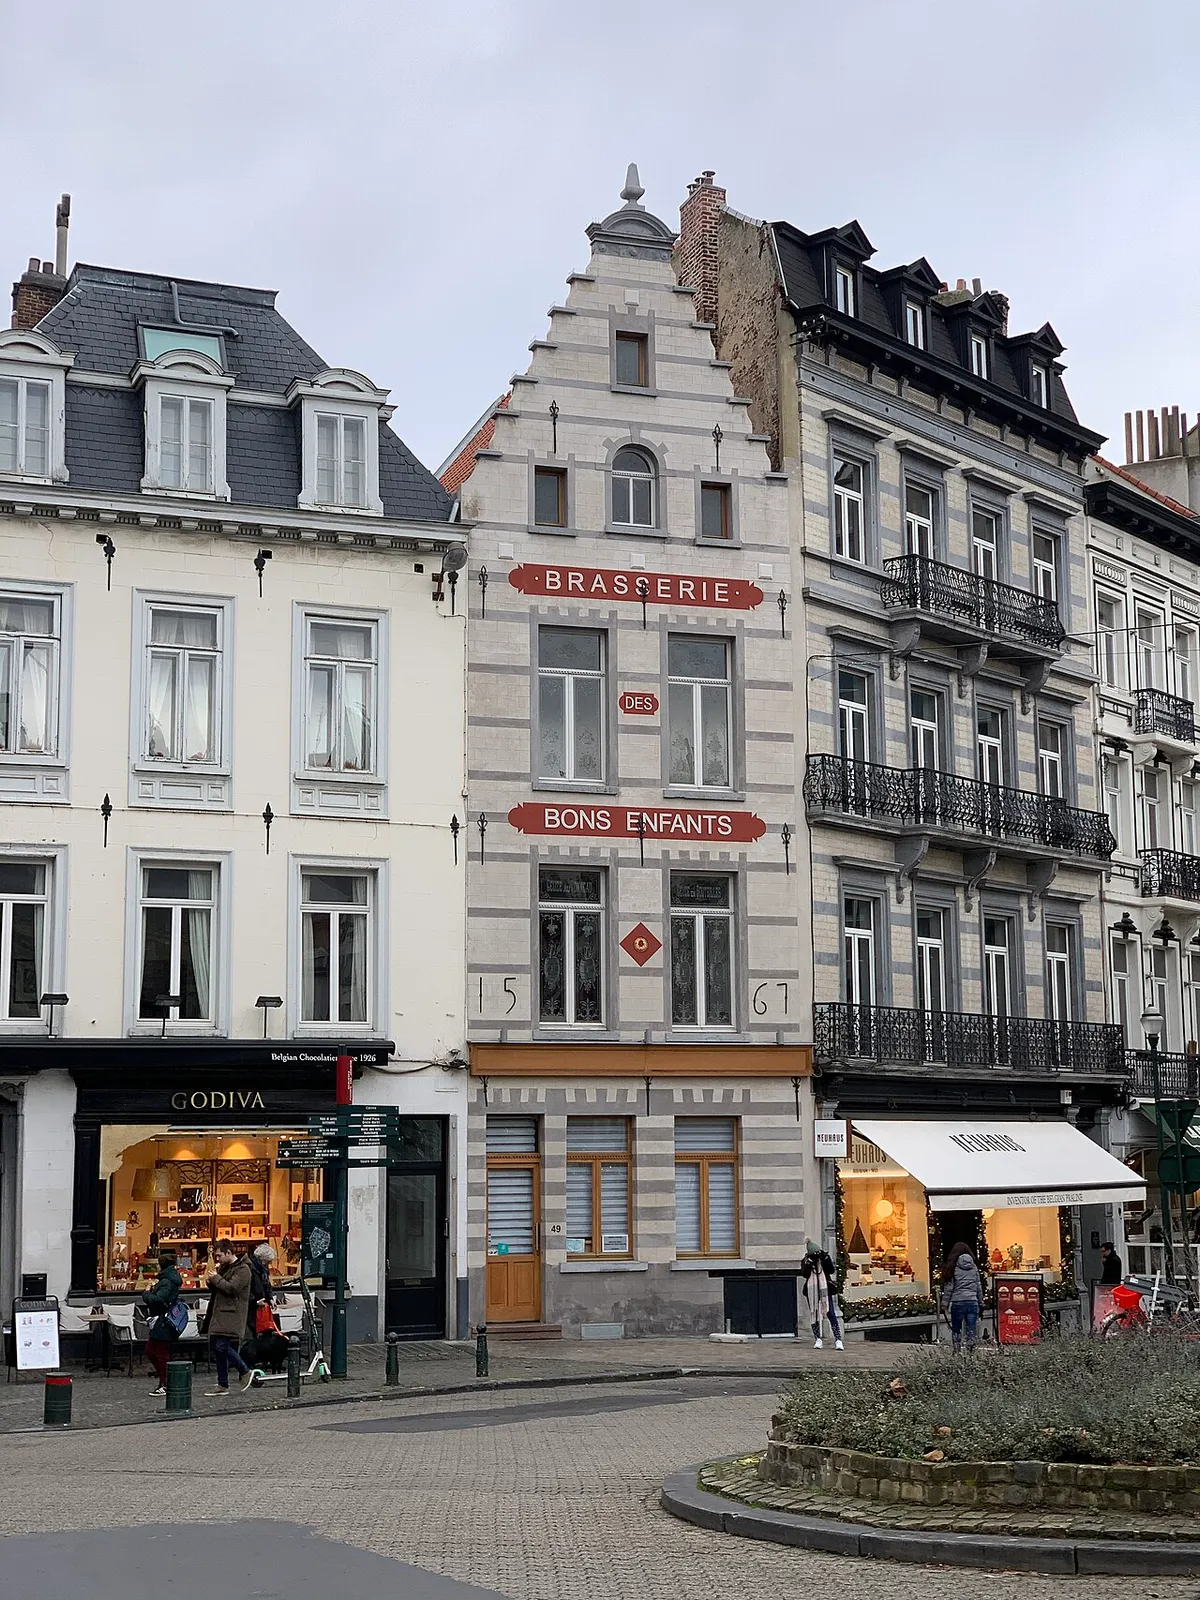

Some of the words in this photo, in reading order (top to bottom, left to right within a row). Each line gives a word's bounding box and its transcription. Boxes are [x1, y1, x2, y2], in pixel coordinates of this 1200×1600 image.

[545, 570, 730, 603] BRASSERIE
[625, 695, 653, 712] DES
[544, 807, 612, 831] BONS
[626, 812, 733, 836] ENFANTS
[271, 1053, 298, 1063] Belgian
[360, 1054, 376, 1062] 1926
[171, 1091, 265, 1110] GODIVA
[816, 1133, 844, 1143] NEUHAUS
[949, 1133, 1026, 1154] NEUHAUS
[844, 1144, 887, 1164] EUHAUS
[551, 1224, 561, 1233] 49
[20, 1300, 53, 1309] GODIVA
